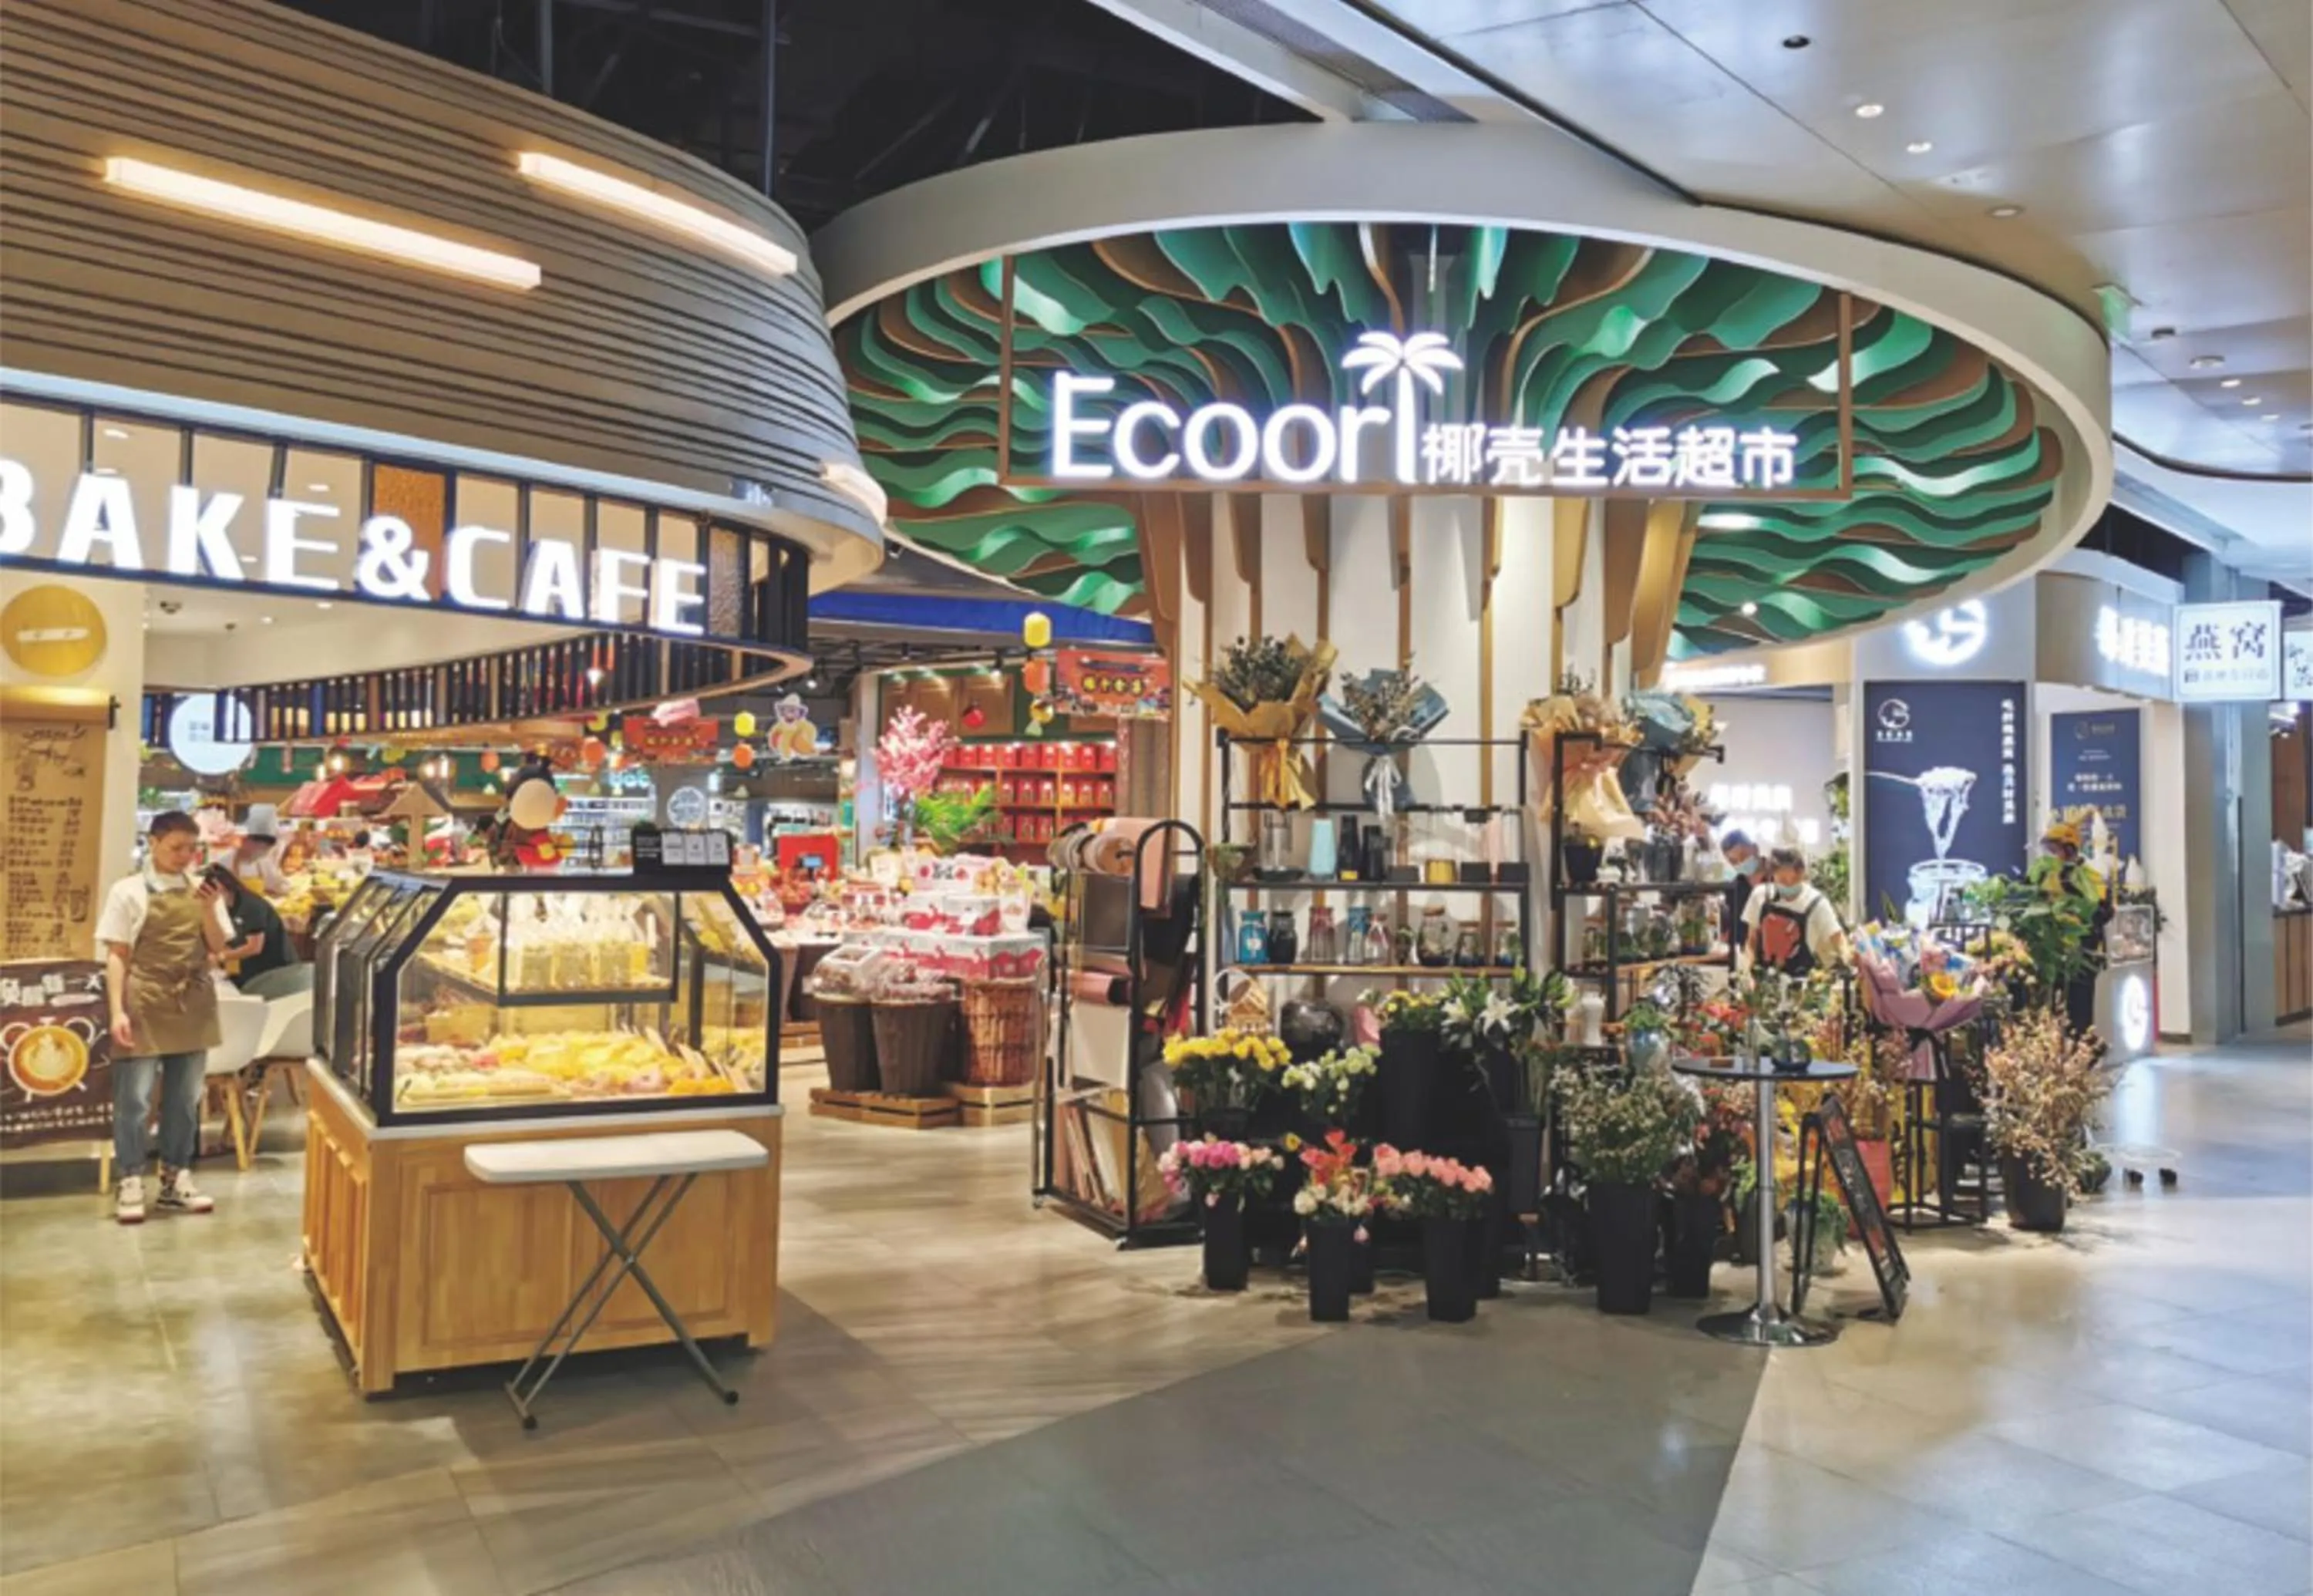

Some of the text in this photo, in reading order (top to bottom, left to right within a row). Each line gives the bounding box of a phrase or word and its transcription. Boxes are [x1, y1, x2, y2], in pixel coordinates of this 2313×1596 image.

[1422, 422, 1798, 489] 椰壳生活超市
